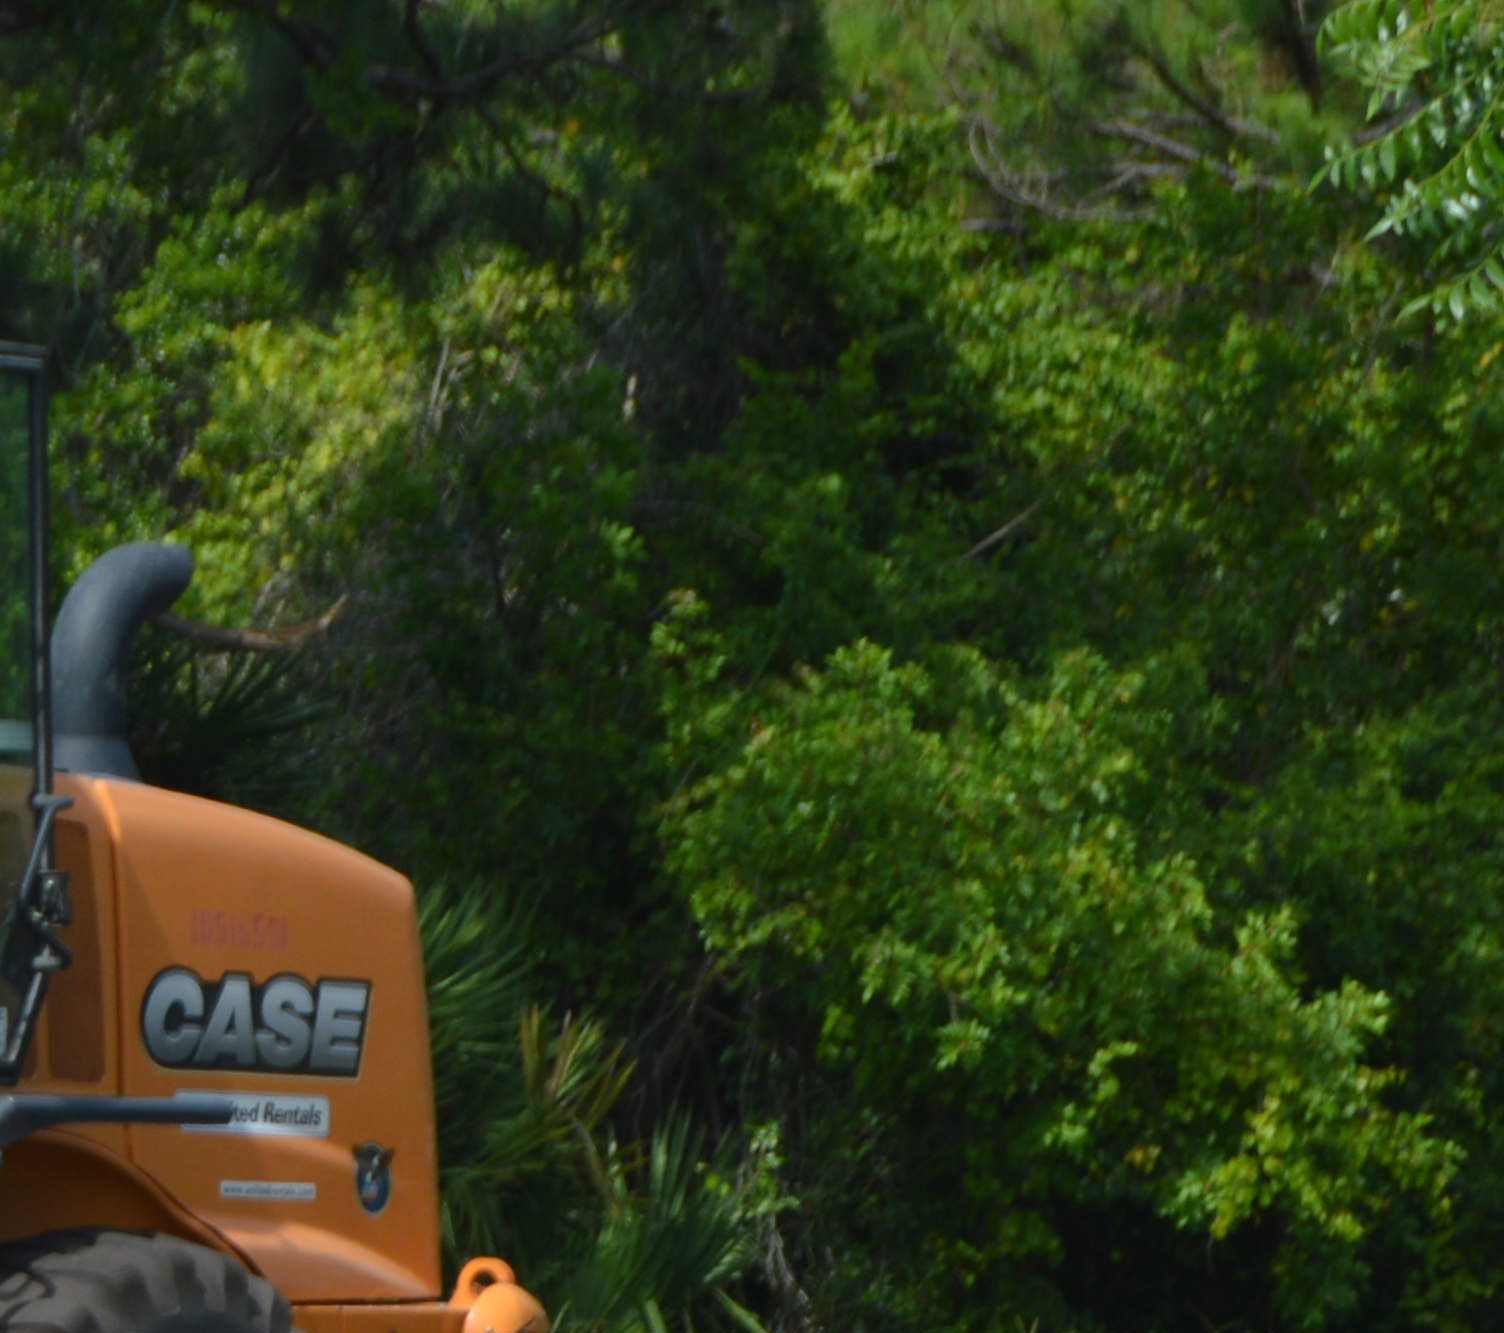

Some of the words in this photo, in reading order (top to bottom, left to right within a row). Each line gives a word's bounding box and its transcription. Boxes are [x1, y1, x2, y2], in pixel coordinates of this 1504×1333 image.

[141, 966, 372, 1078] CASE
[231, 1102, 260, 1123] ted
[263, 1102, 322, 1126] Rentals
